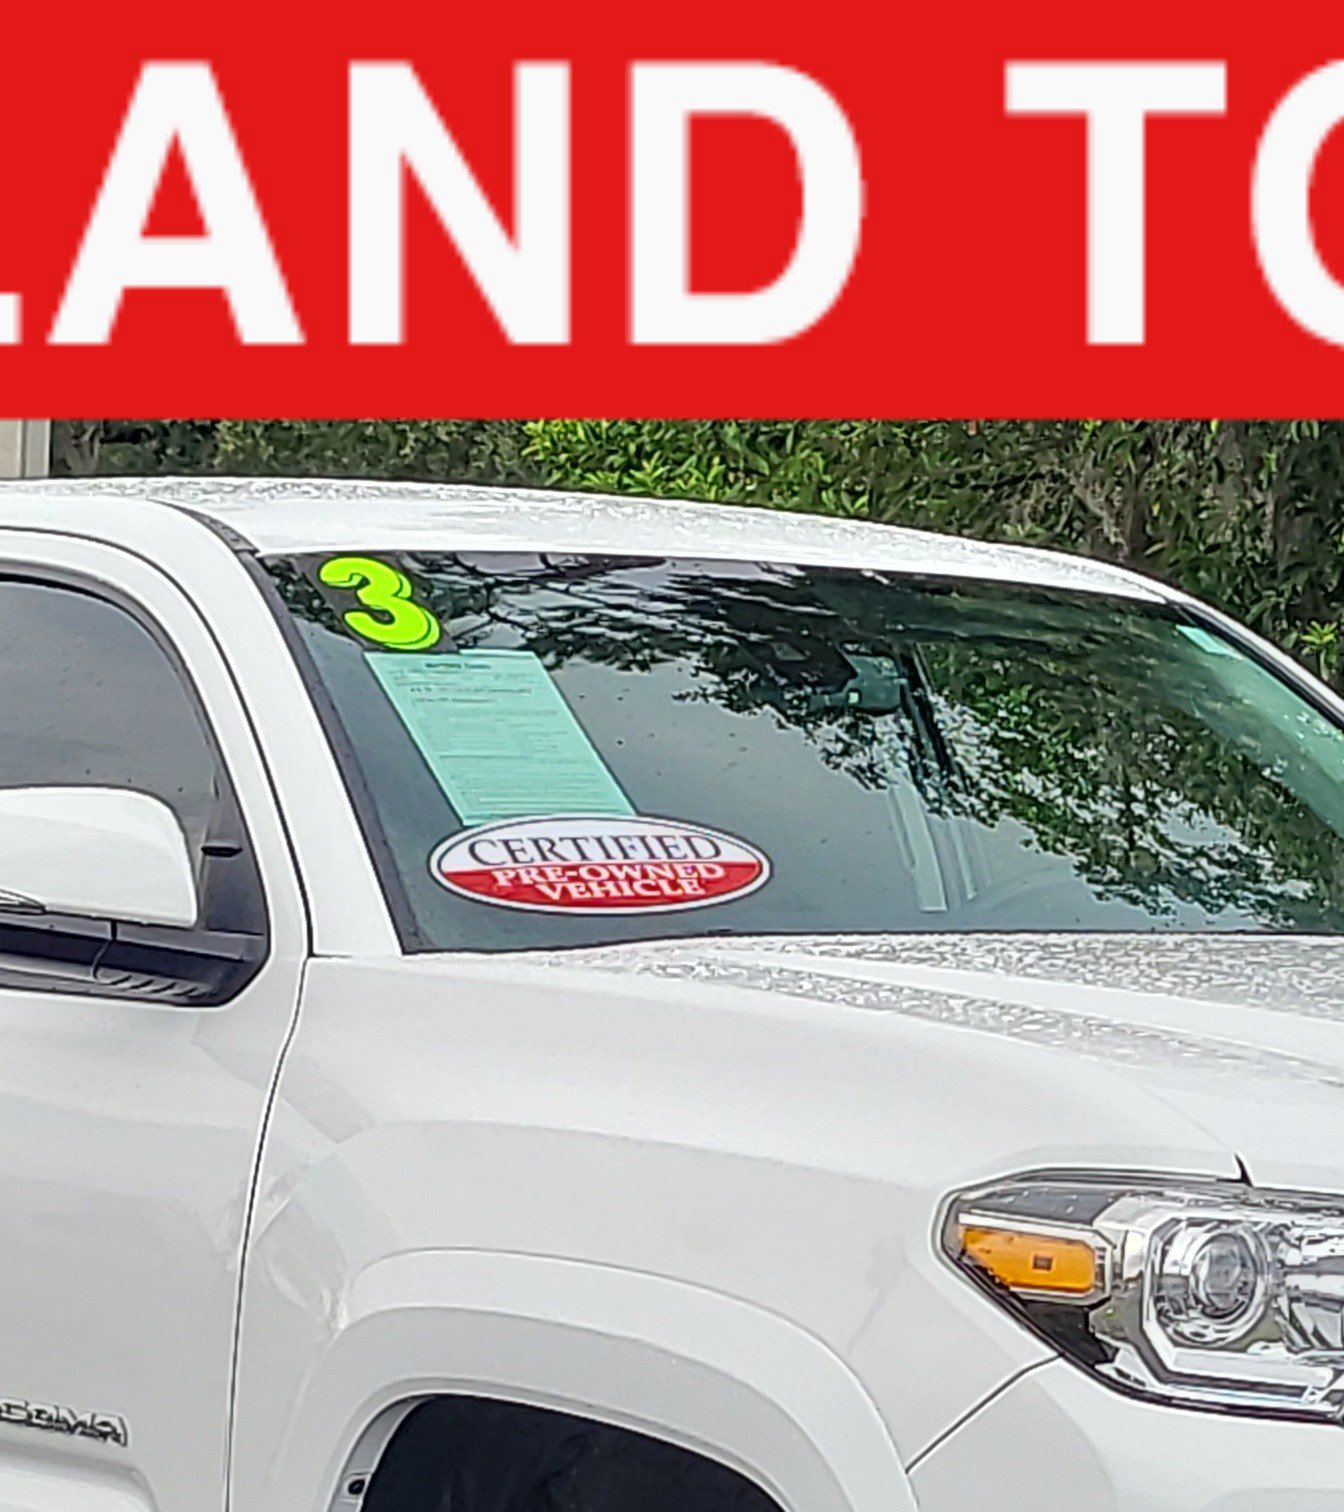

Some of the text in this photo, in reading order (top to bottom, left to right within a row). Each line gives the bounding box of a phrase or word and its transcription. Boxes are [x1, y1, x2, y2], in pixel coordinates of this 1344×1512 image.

[467, 834, 723, 867] CERTIFIED
[490, 862, 726, 888] PRE-OWNED
[533, 880, 707, 902] VEHICLE
